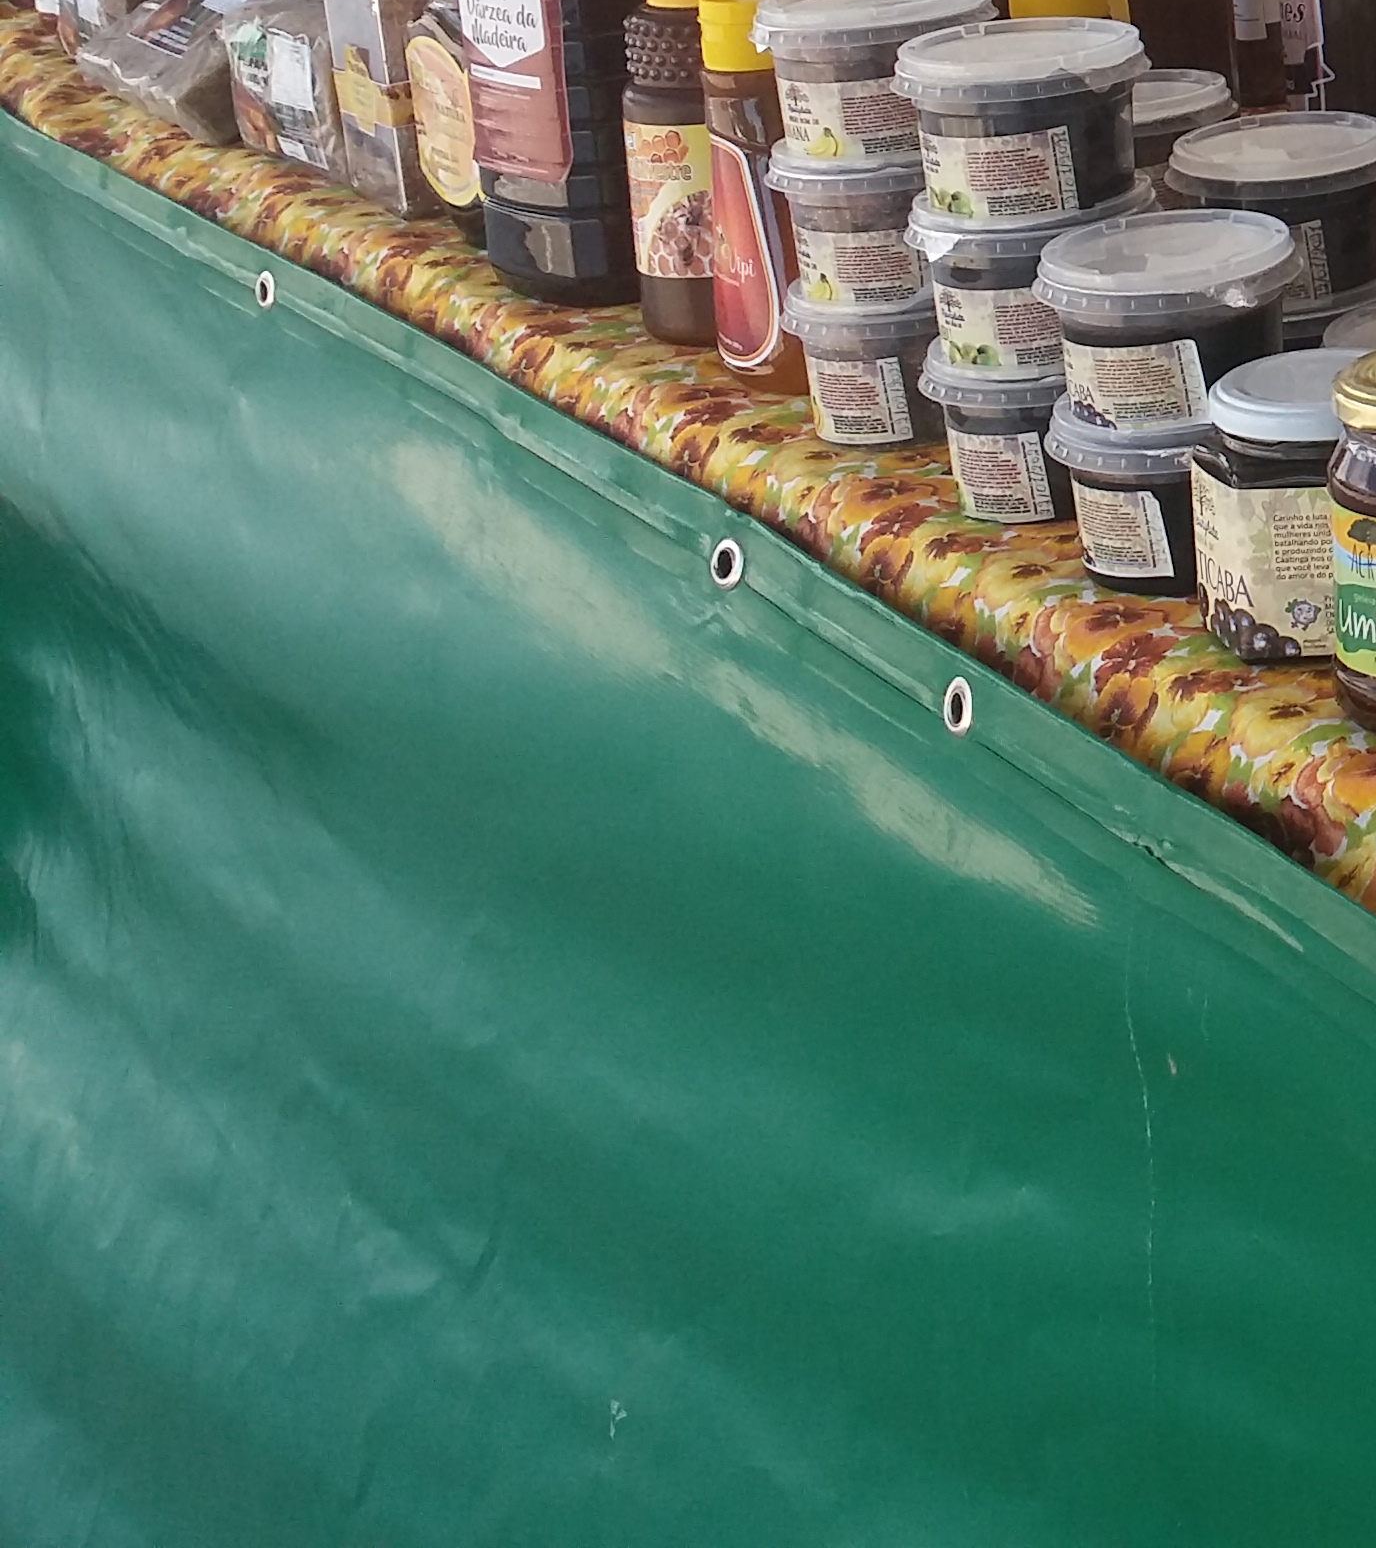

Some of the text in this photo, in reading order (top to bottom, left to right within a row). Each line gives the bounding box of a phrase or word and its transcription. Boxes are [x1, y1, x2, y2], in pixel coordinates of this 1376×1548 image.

[516, 4, 537, 29] da
[471, 18, 527, 53] Madeira
[1275, 555, 1308, 564] Caatinga
[1282, 547, 1326, 556] produzindo
